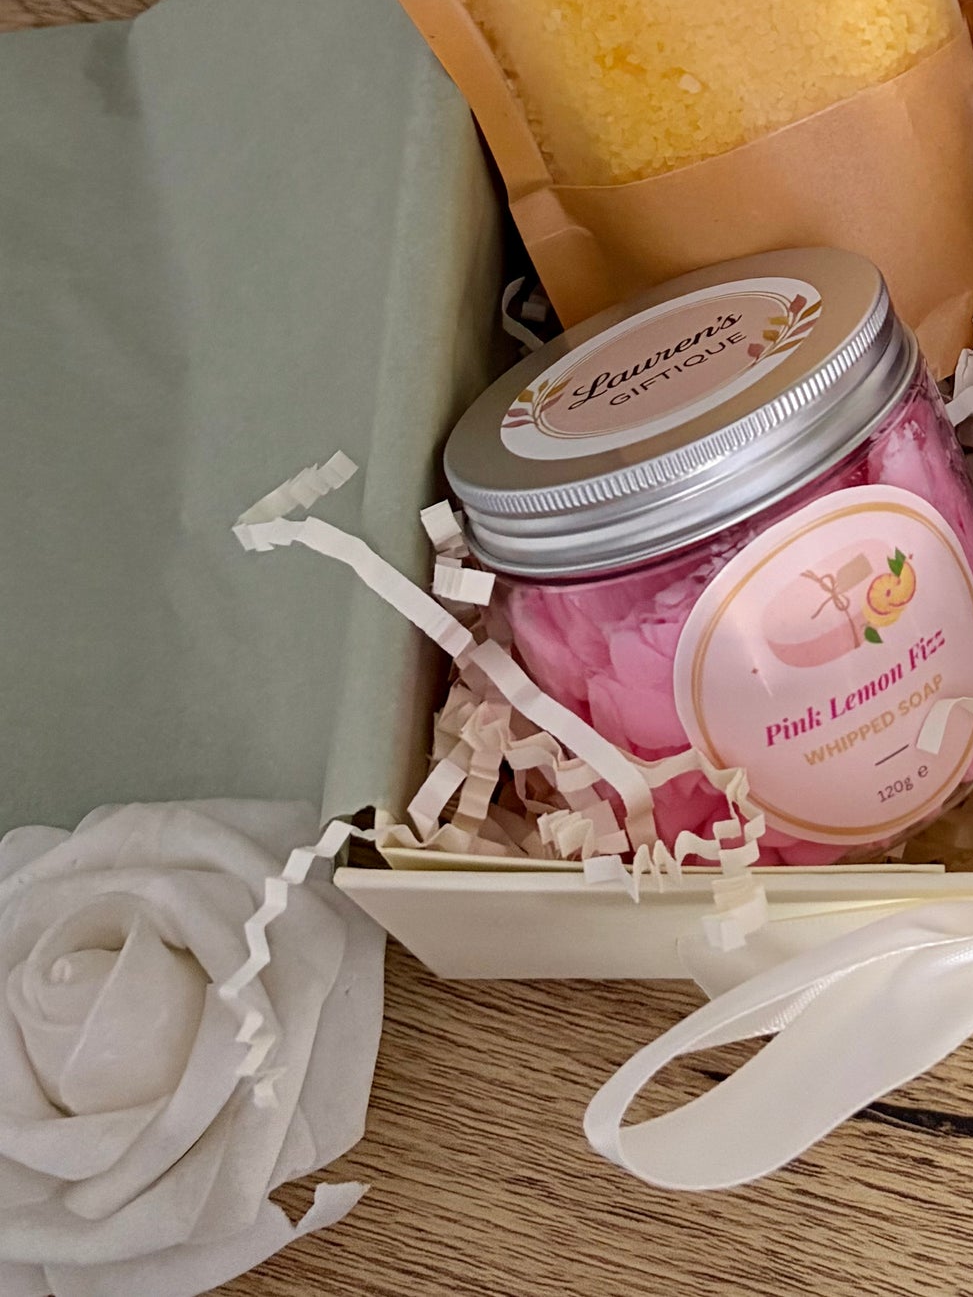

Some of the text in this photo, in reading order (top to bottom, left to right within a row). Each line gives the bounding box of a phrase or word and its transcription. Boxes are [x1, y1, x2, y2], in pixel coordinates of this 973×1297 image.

[568, 313, 742, 410] Lauren's
[609, 331, 747, 406] GIFTIQUE
[765, 629, 946, 747] Pink Lemon Fizz
[803, 674, 943, 766] WHIPPED SOAP
[877, 776, 914, 802] 120g
